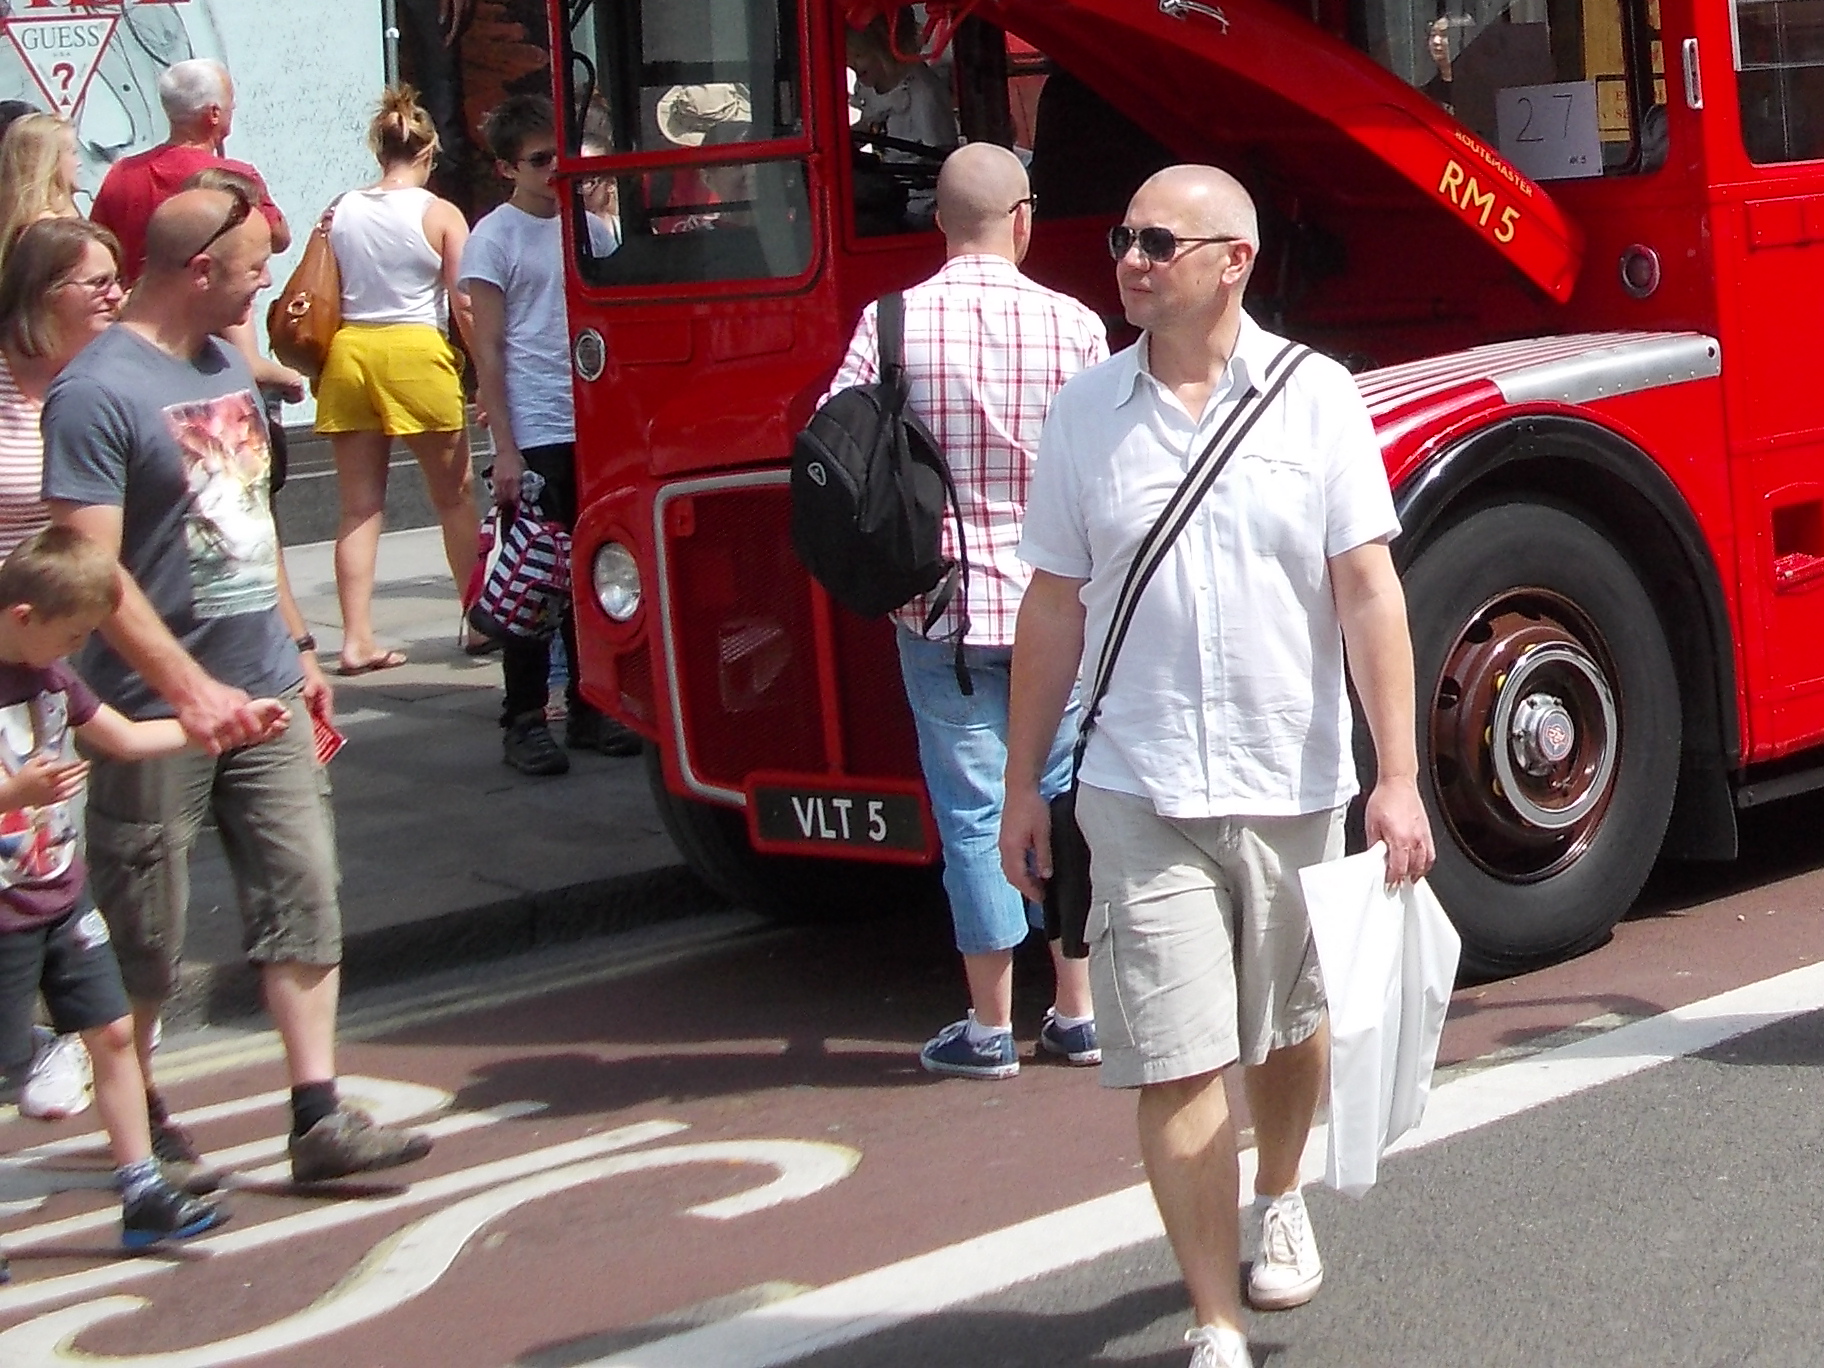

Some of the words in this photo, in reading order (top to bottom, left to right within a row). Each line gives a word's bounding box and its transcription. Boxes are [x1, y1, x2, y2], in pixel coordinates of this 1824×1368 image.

[21, 25, 99, 50] GUESS
[1454, 130, 1533, 198] ROUTEMASTER
[1438, 159, 1496, 227] RM
[1494, 205, 1520, 243] 5
[790, 796, 853, 839] VLT
[868, 800, 887, 842] 5
